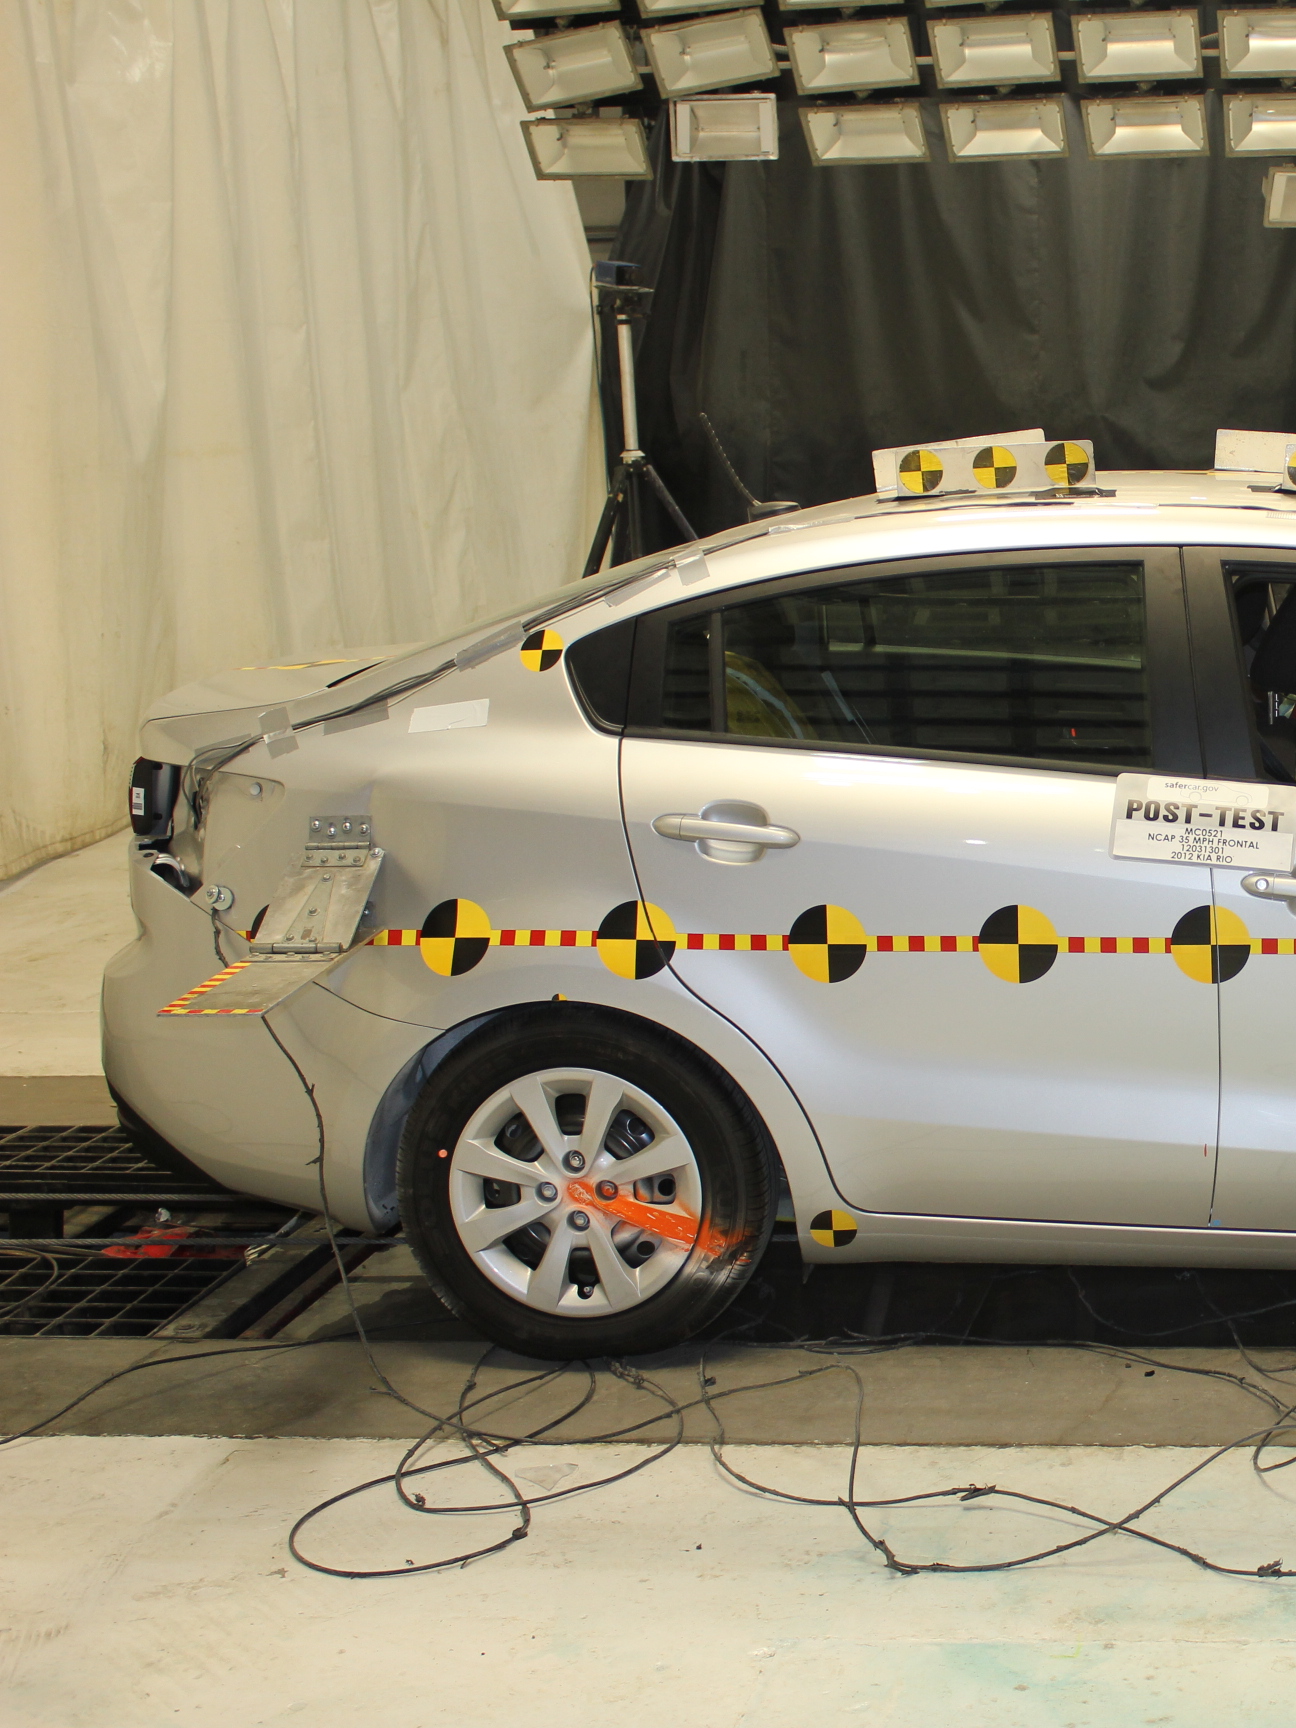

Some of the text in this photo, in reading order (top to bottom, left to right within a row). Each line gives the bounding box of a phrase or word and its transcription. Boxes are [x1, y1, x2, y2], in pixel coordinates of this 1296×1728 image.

[1164, 781, 1219, 793] safercar.gov
[1125, 799, 1285, 832] POST-TEST
[1184, 827, 1223, 838] MC0521
[1147, 833, 1259, 850] NCAP 35 MPH FRONTAL
[1181, 844, 1225, 854] 12031301
[1171, 851, 1232, 864] 2012 KIA RIO
